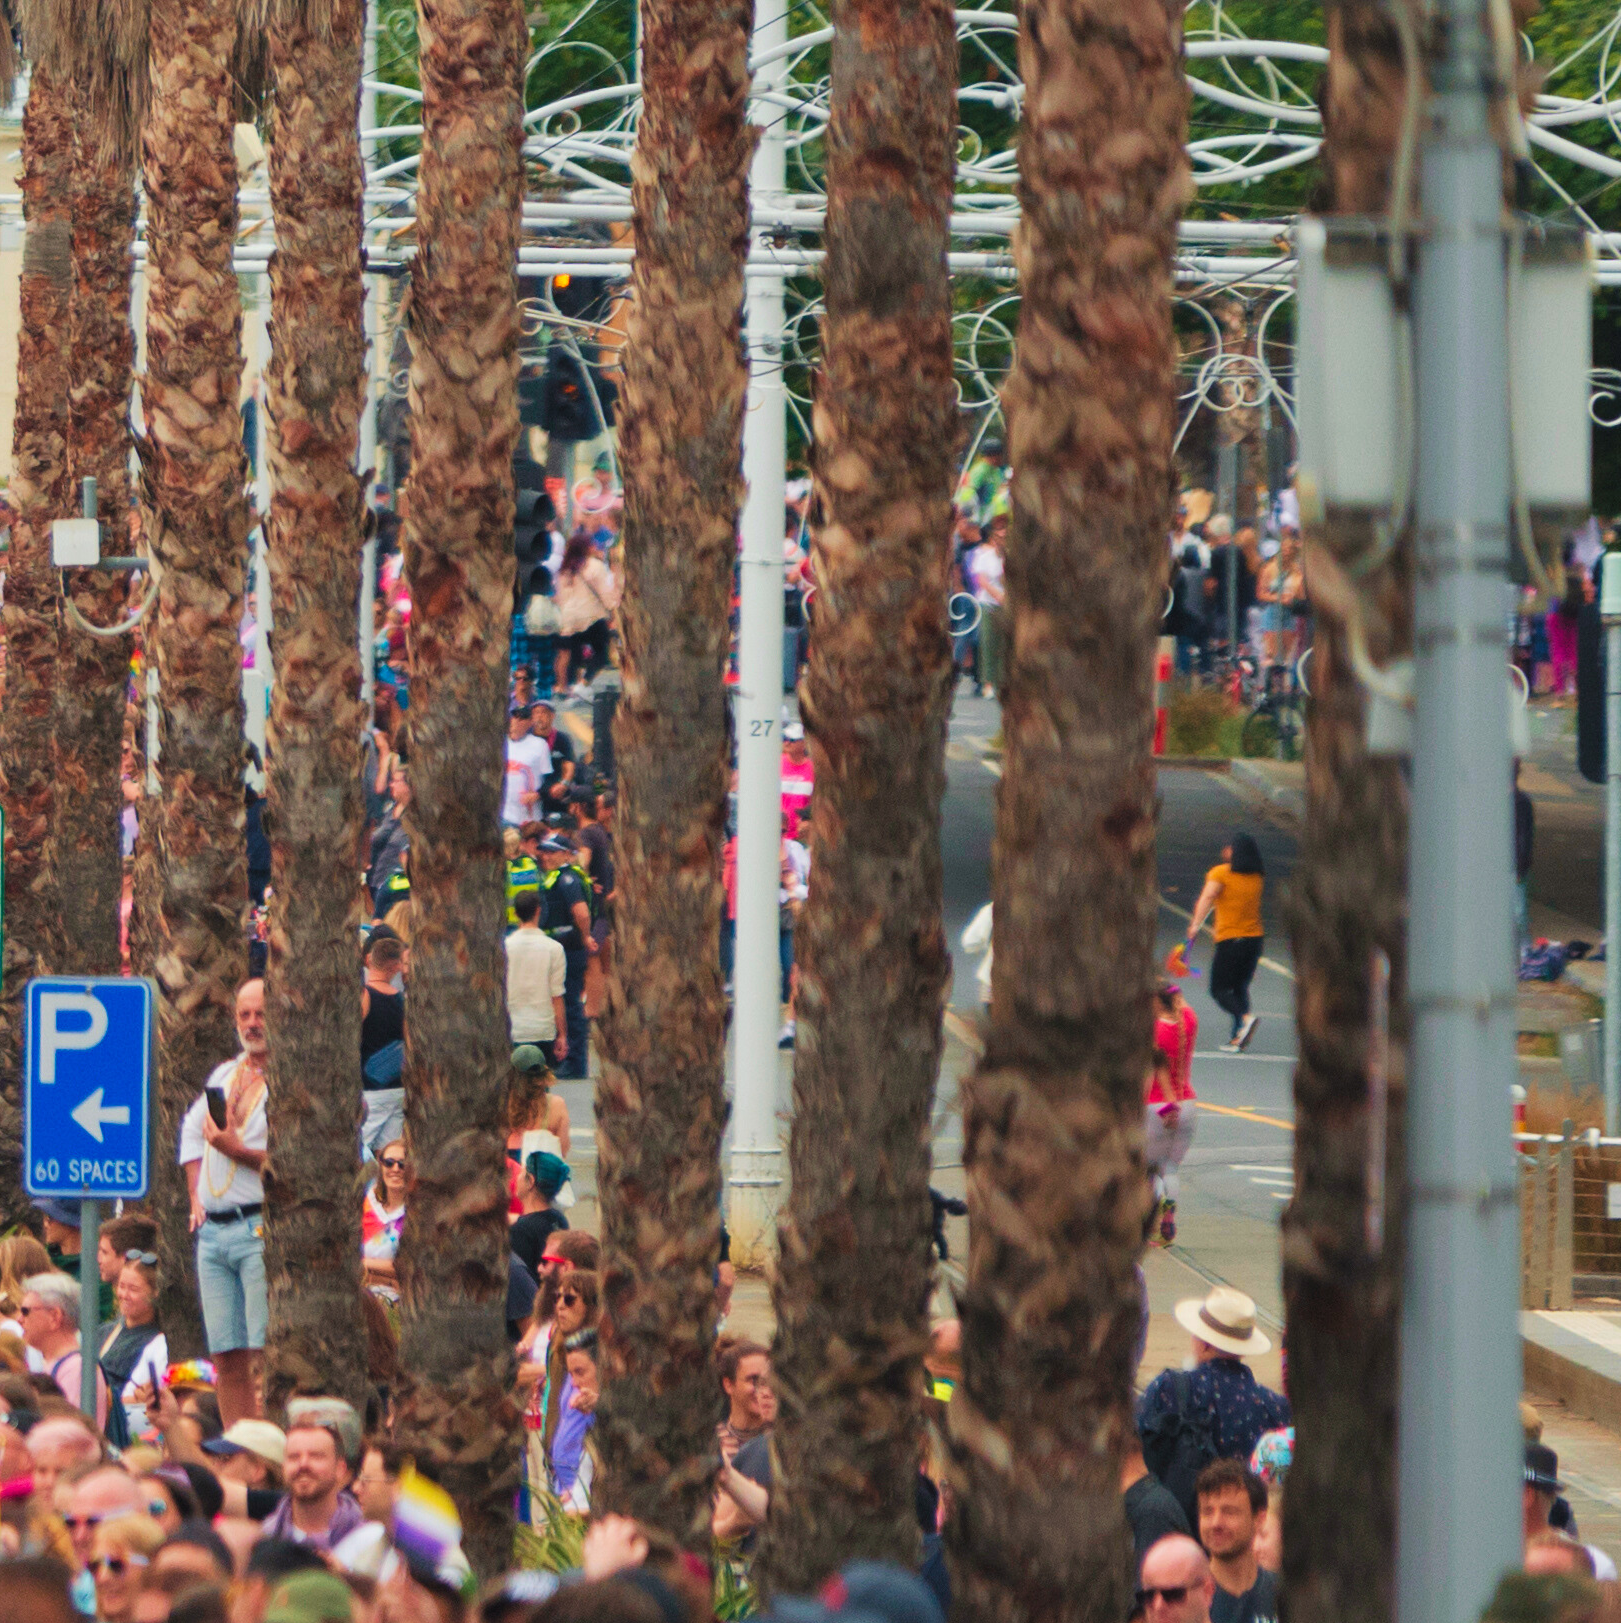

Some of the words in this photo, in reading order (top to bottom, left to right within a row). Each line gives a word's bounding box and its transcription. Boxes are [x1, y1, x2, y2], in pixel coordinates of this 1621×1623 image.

[750, 719, 774, 737] 27
[39, 992, 108, 1084] P
[34, 1158, 59, 1182] 60
[69, 1159, 138, 1184] SPACES
